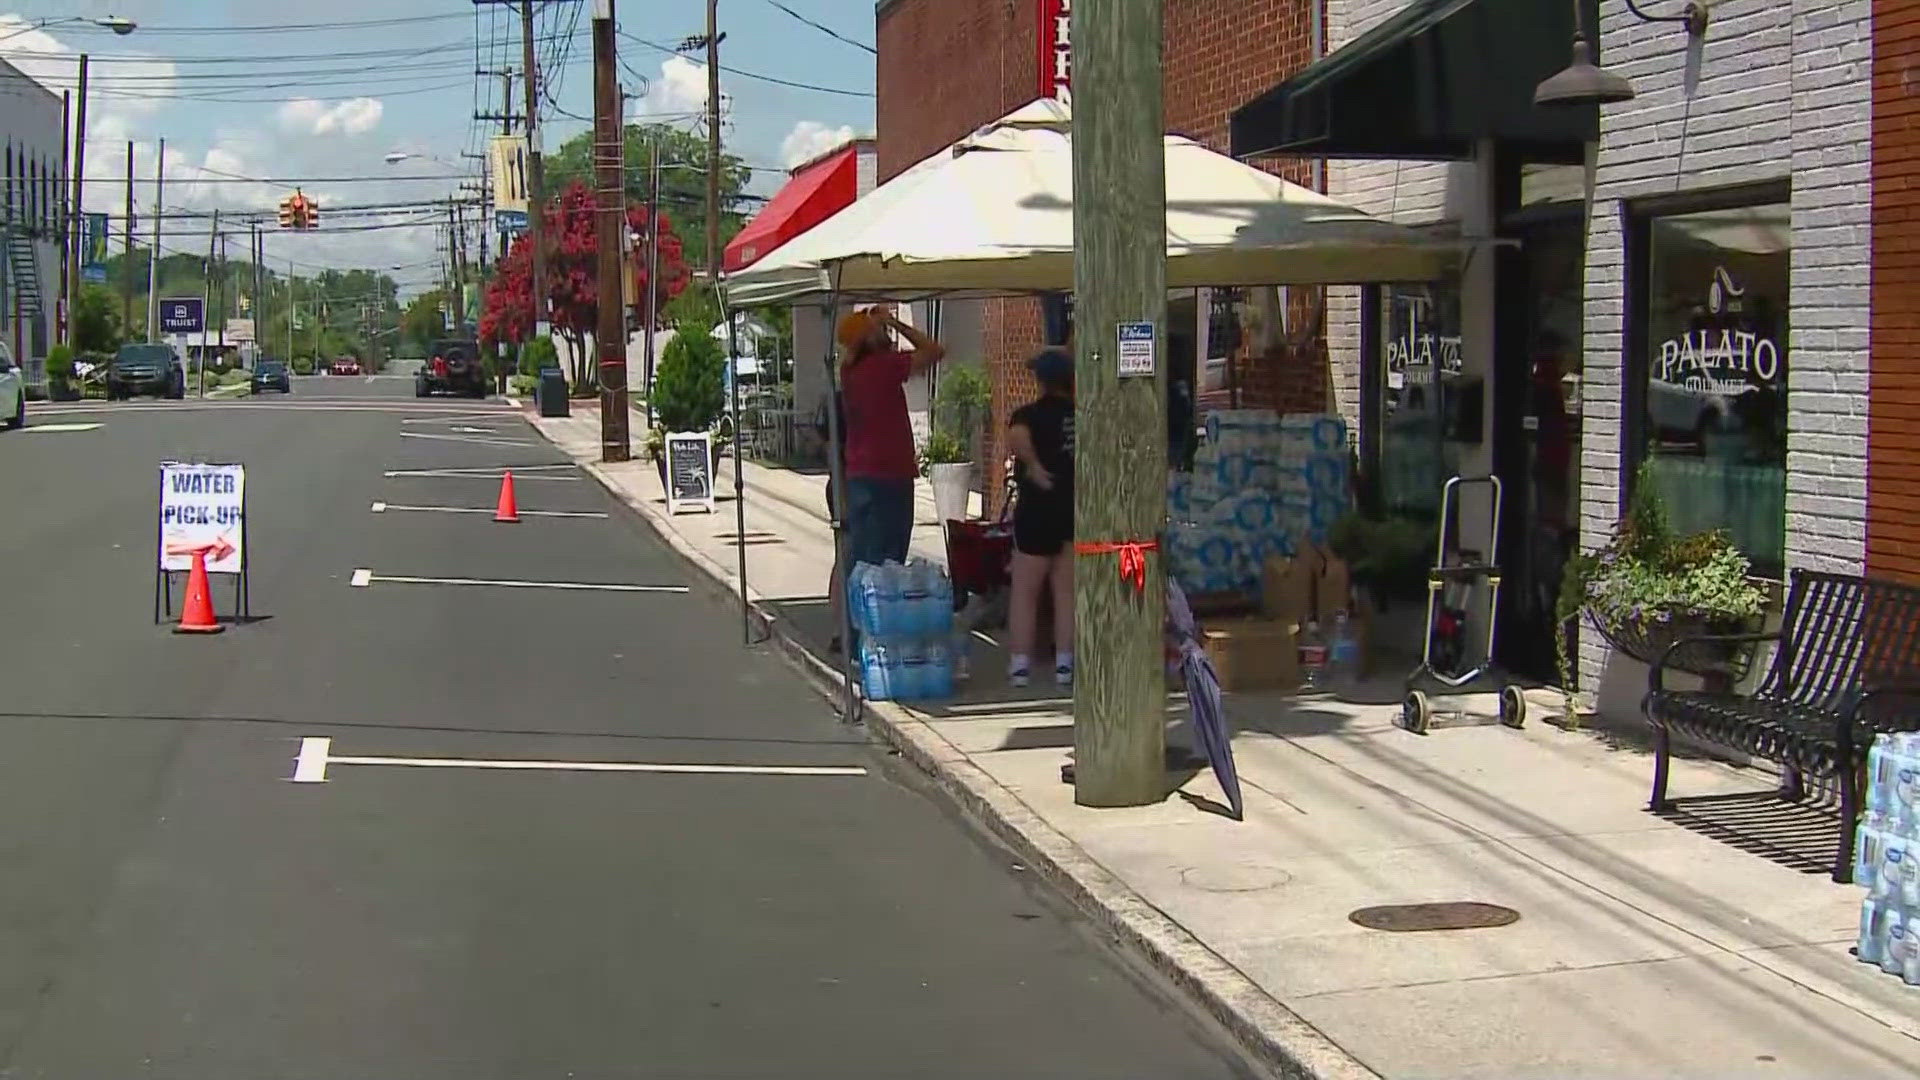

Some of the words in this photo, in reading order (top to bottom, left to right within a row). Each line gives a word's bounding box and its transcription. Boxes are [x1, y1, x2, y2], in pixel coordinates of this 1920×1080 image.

[165, 318, 198, 327] TRUIST
[1660, 329, 1777, 380] PALATO
[172, 473, 235, 494] WATER
[164, 505, 242, 525] PICK-UP
